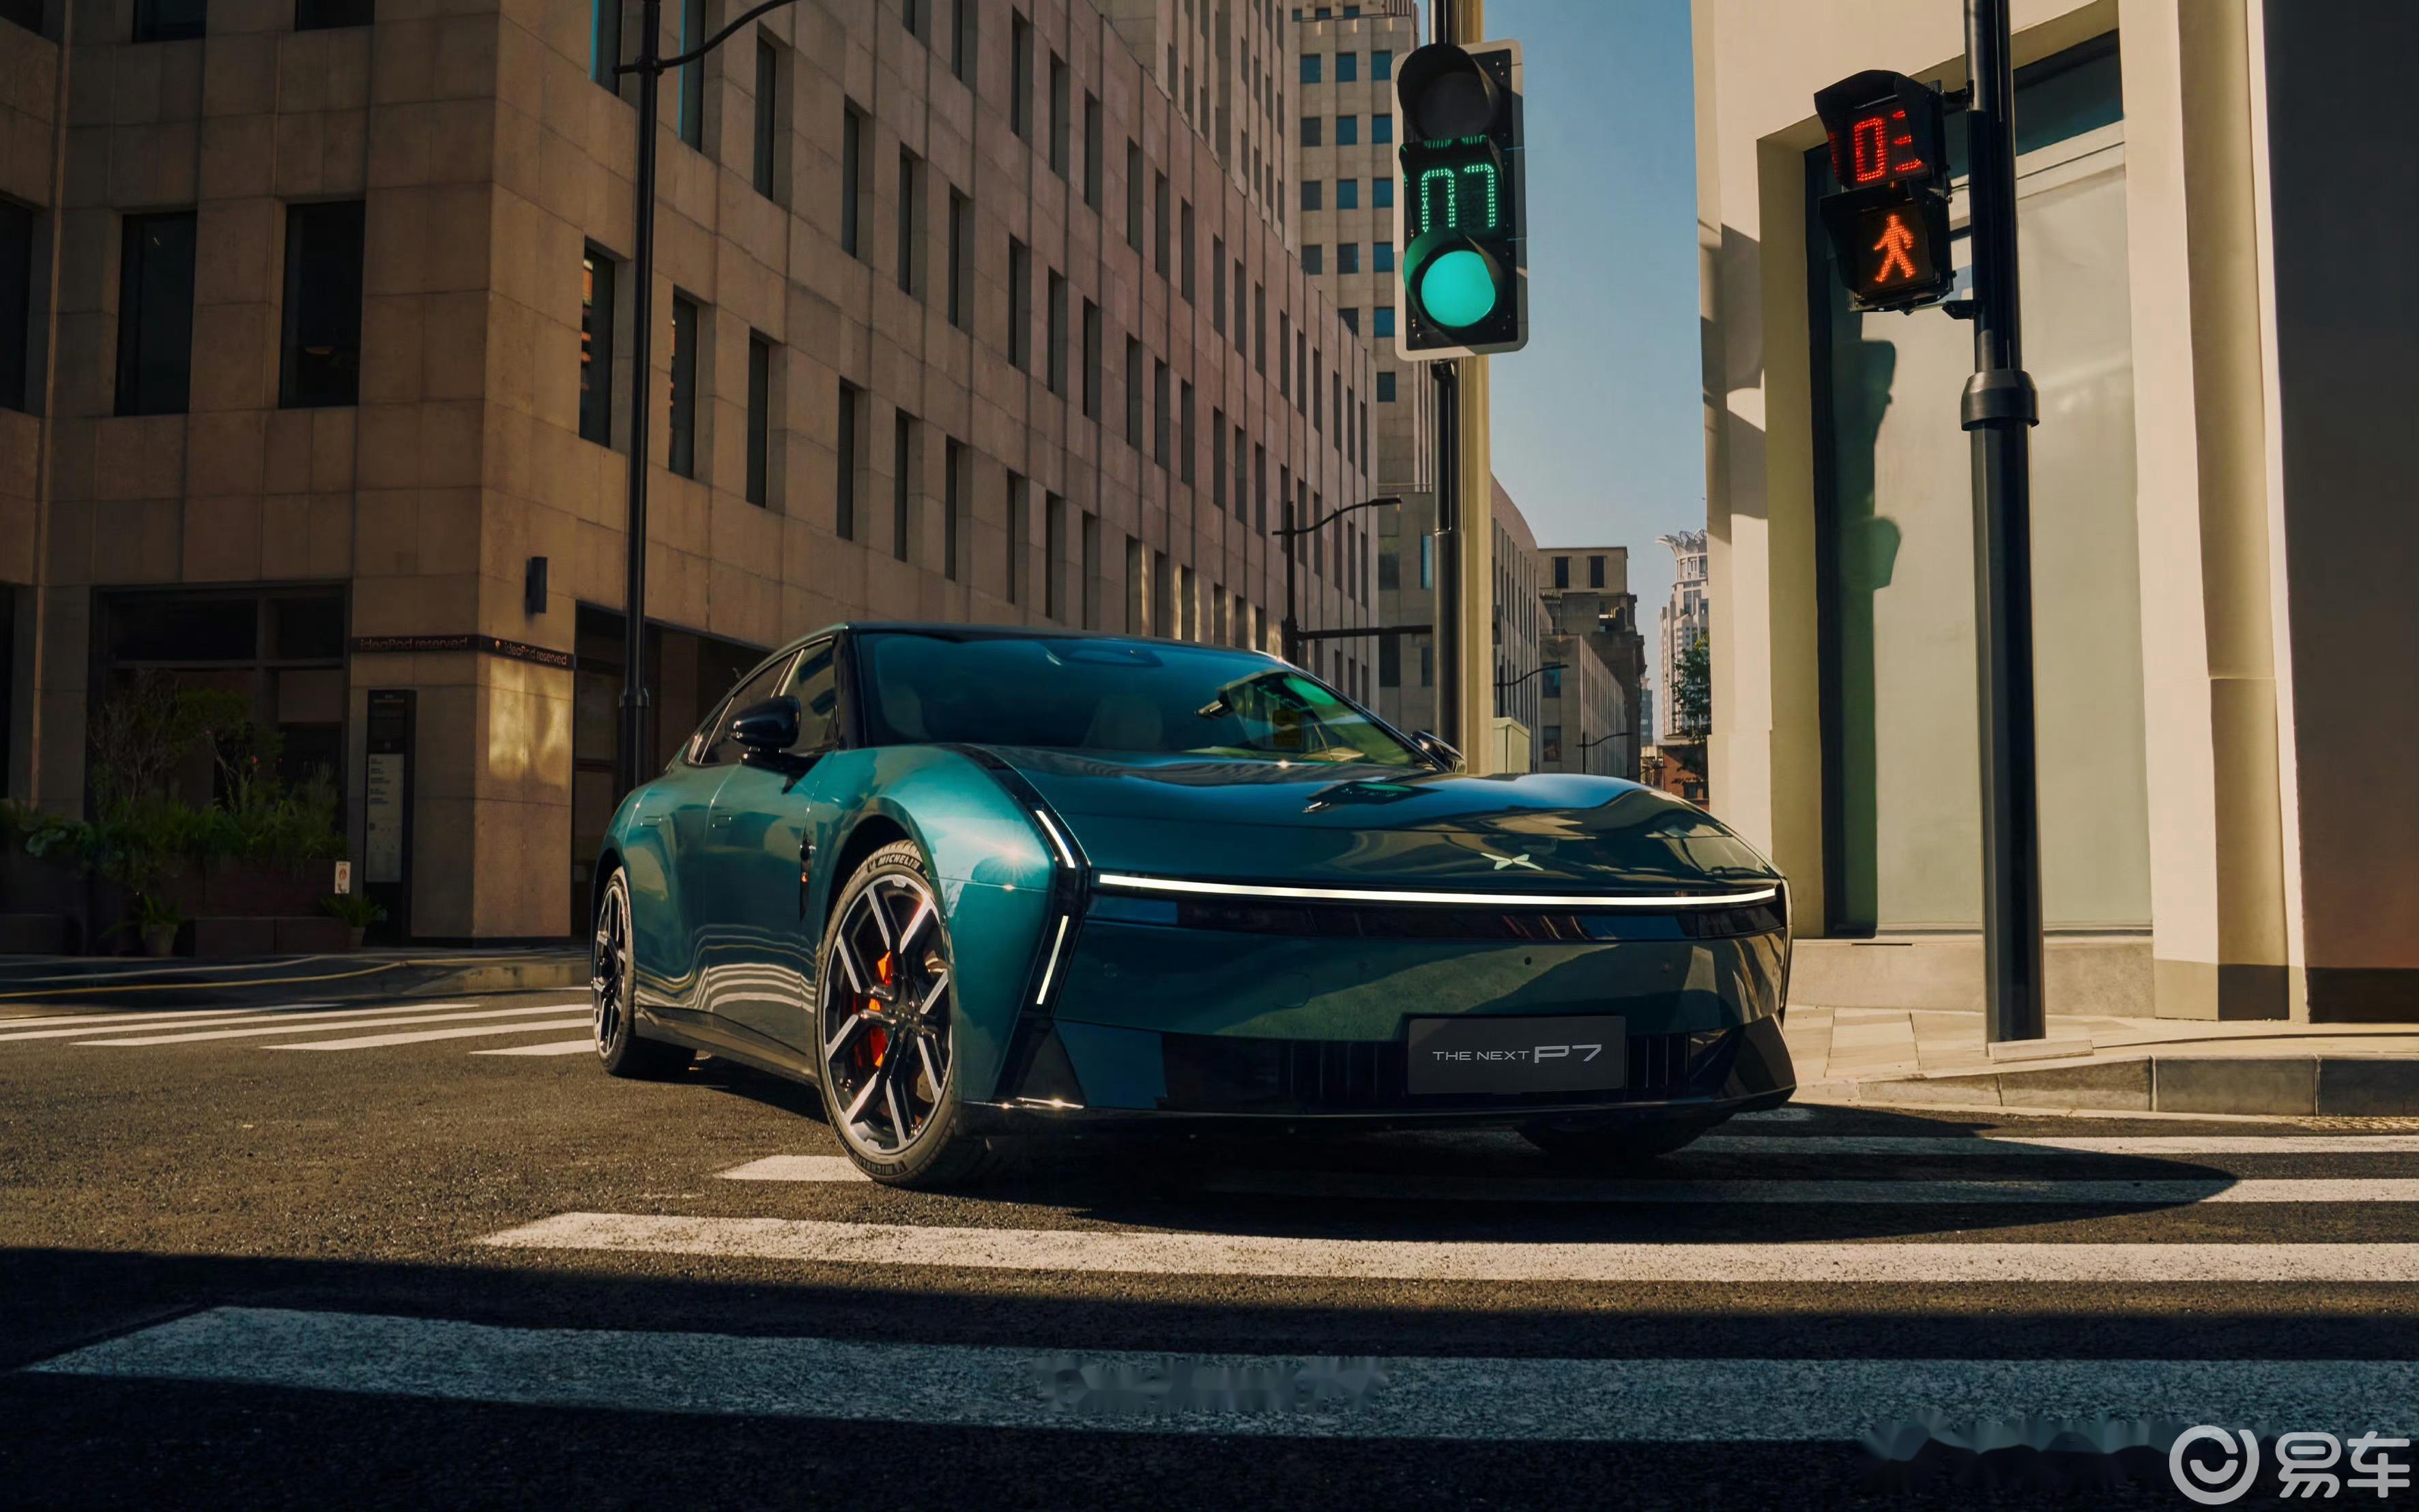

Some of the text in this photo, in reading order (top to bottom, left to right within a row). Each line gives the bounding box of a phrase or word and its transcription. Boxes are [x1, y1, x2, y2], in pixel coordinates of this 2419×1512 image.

[415, 637, 467, 649] reserved
[536, 651, 567, 665] reserved
[877, 853, 921, 871] MICHELIN
[1432, 1044, 1602, 1064] THE NEXT P7
